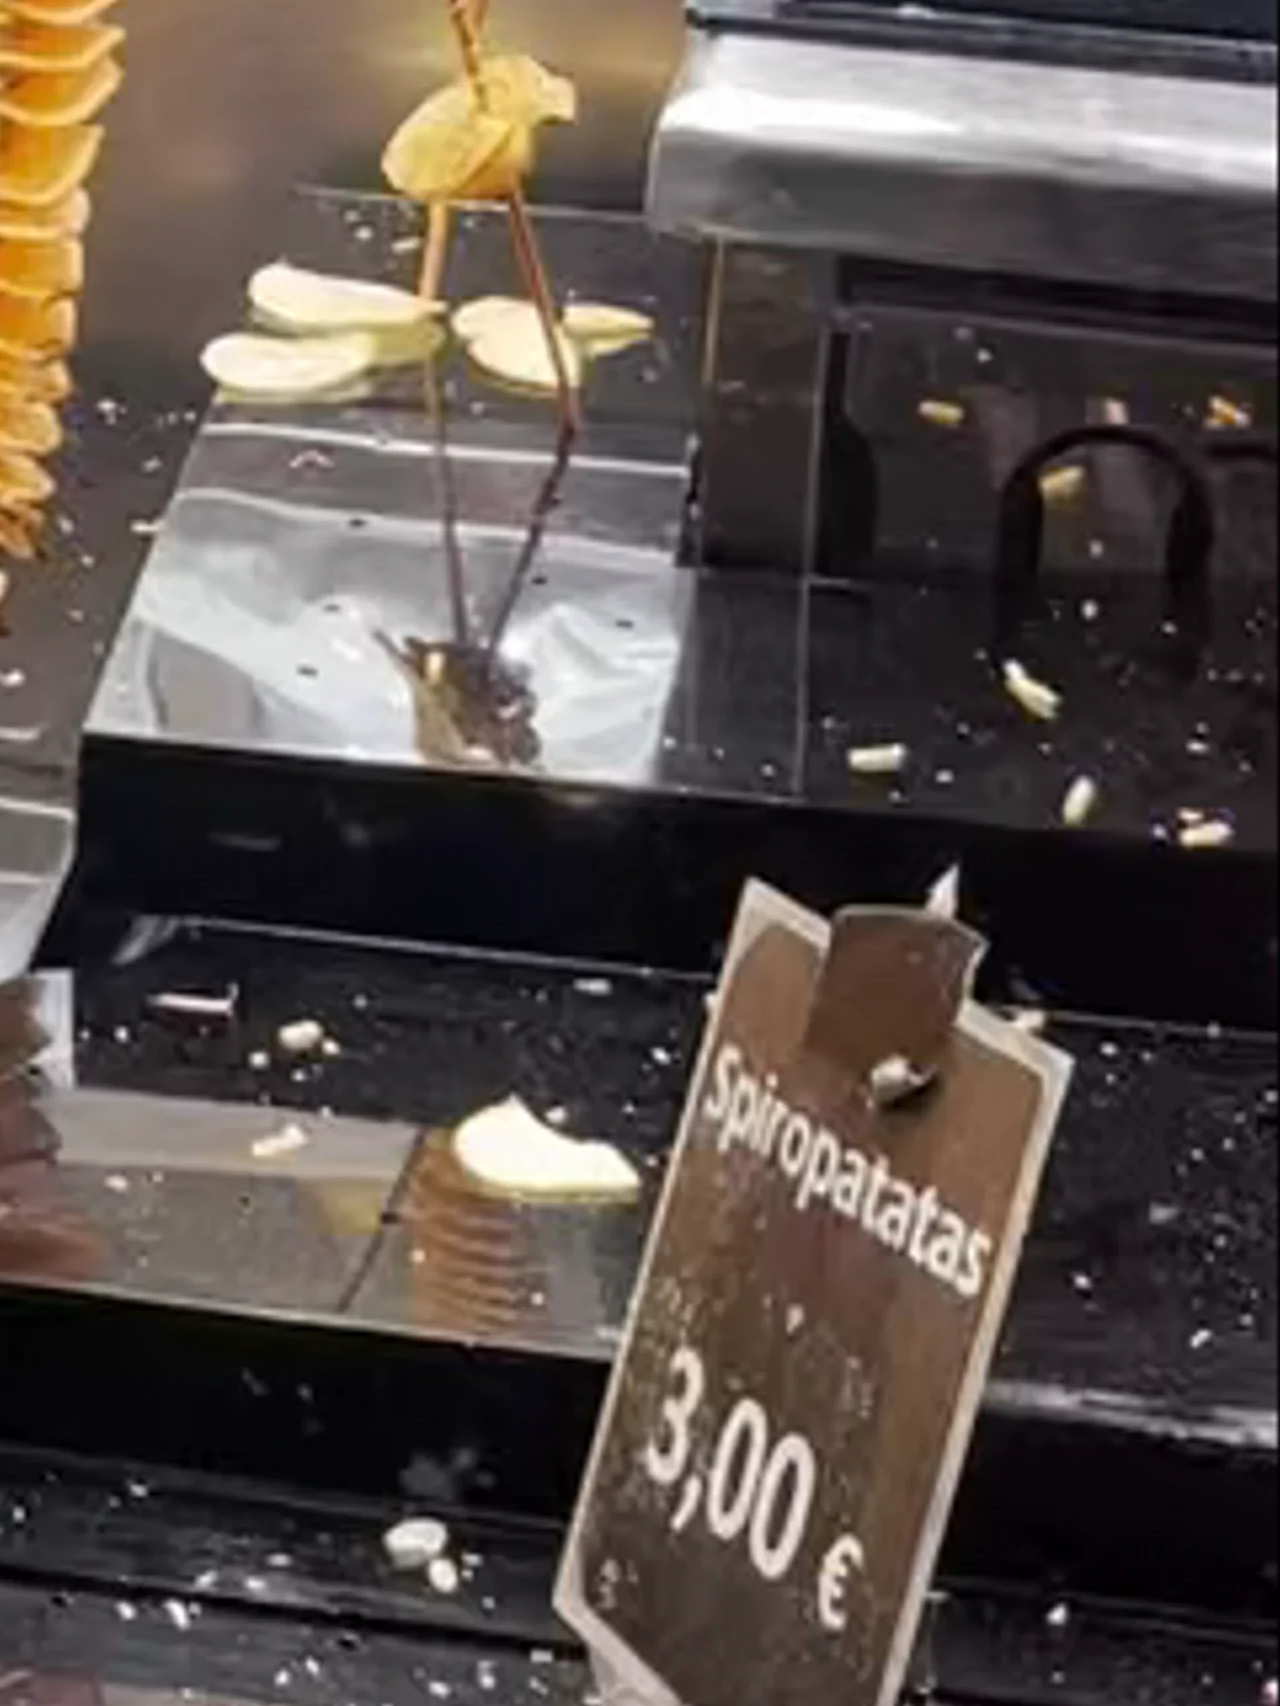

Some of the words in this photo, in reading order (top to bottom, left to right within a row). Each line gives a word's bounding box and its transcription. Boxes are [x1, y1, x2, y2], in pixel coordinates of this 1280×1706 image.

[707, 1046, 990, 1295] Spiropatatas
[645, 1350, 816, 1582] 3,00
[818, 1532, 862, 1628] €
